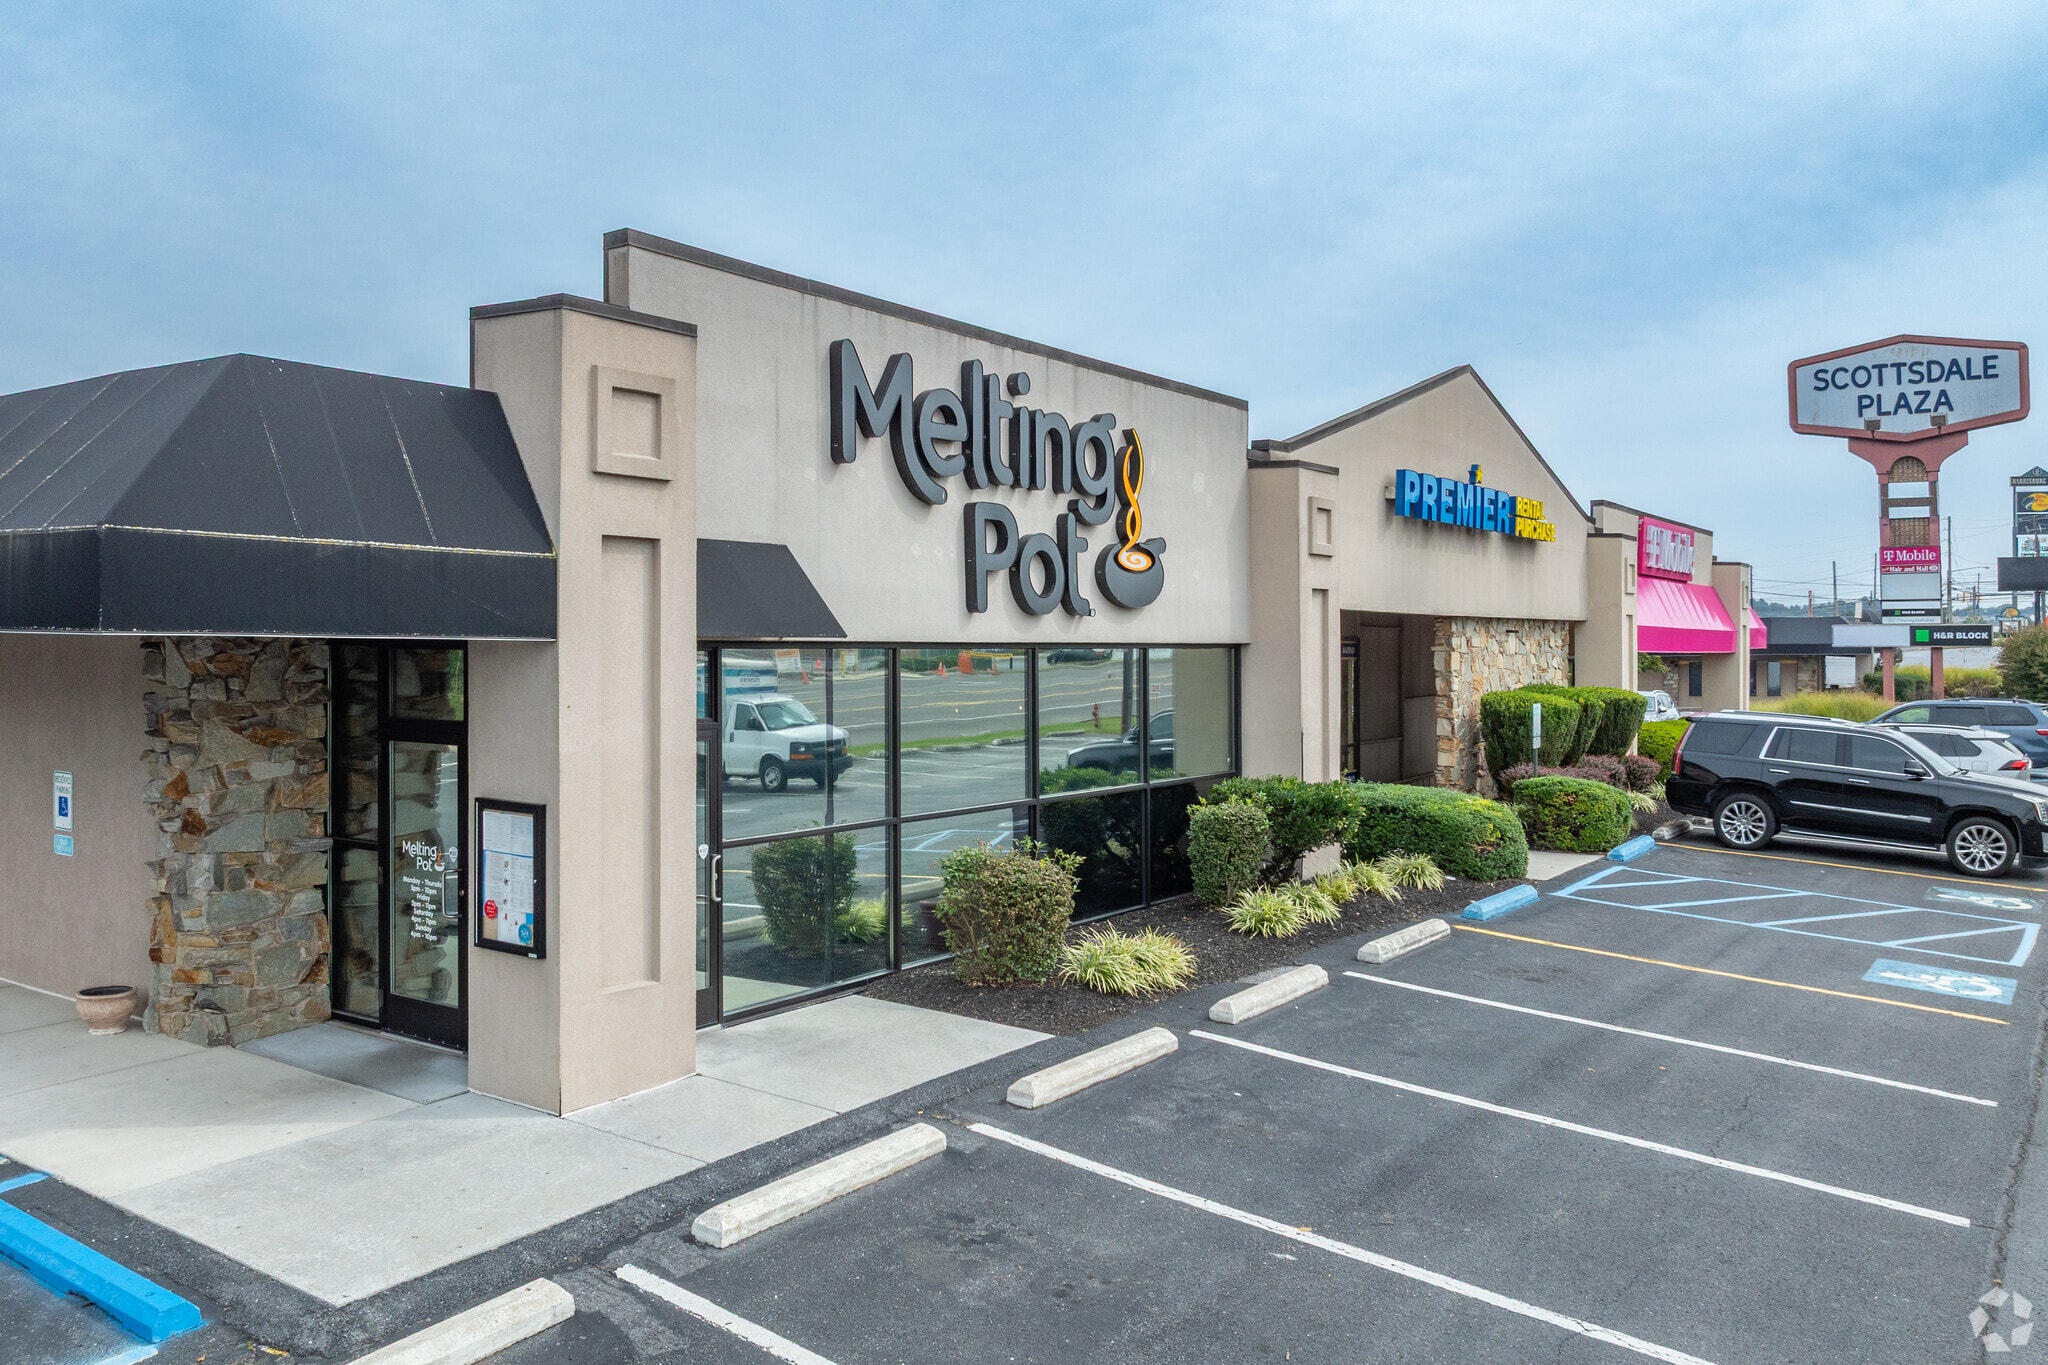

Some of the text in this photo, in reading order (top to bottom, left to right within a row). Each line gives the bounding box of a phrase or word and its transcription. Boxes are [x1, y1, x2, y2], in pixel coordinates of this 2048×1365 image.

[1813, 354, 1999, 391] SCOTTSDALE
[1857, 389, 1954, 418] PLAZA
[830, 338, 1117, 526] Melting
[1395, 468, 1511, 535] PREMIER
[1516, 495, 1546, 521] RENTAL
[1516, 517, 1556, 542] PURCHASE
[963, 501, 1090, 617] Pot
[1896, 549, 1937, 561] Mobile
[1933, 631, 1989, 640] H&R BLOCK
[402, 840, 437, 860] Melting
[416, 856, 432, 871] Pot
[403, 876, 420, 885] Monday
[424, 879, 443, 888] Thursda
[416, 893, 430, 902] Friday
[424, 887, 437, 895] 10pm
[413, 908, 433, 918] Saturday
[415, 923, 432, 934] Sunday
